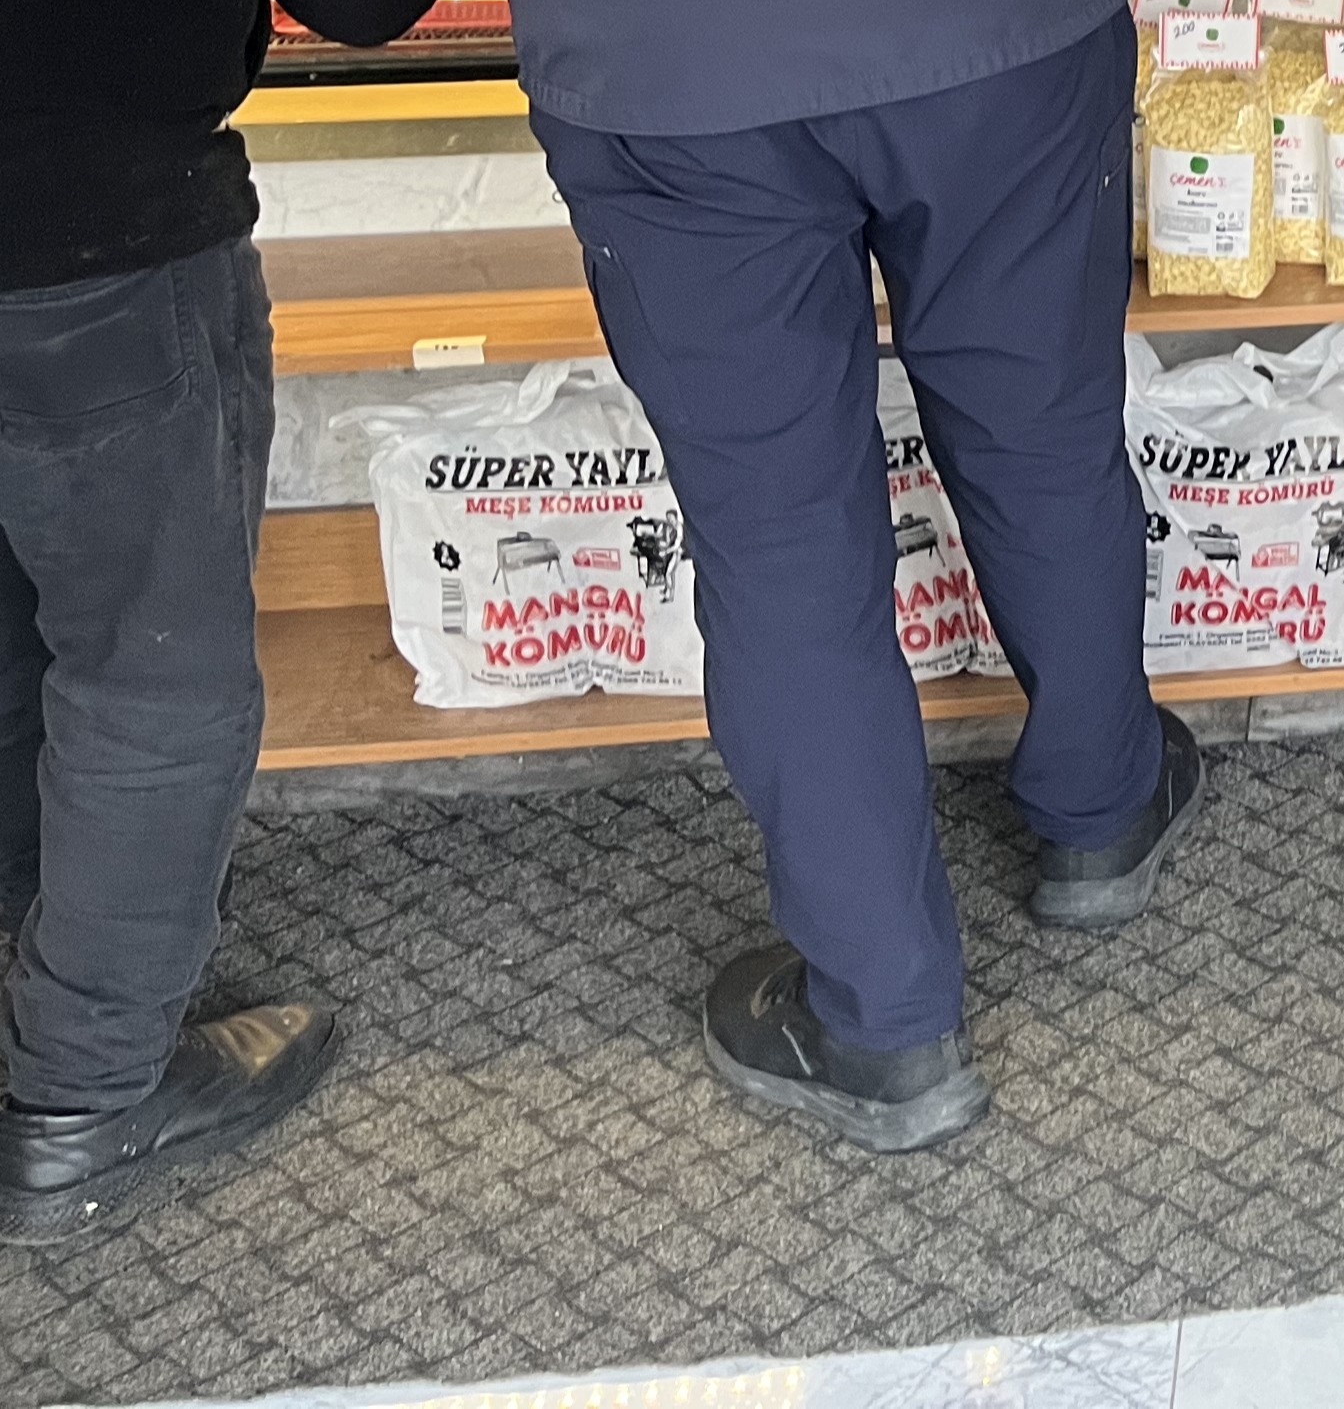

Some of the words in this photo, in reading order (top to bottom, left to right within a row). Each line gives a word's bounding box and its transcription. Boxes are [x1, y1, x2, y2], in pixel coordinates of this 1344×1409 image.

[1173, 20, 1196, 40] 200
[425, 446, 556, 489] SÜPER
[465, 495, 531, 520] MEŞE
[539, 490, 644, 515] KÖMÜRÜ
[1168, 483, 1229, 507] MEŞE
[1237, 477, 1335, 506] KÖMÜRÜ
[482, 584, 646, 632] MANGAL
[1176, 565, 1327, 612] MAGAL
[482, 613, 647, 668] KÖMÜRÜ
[1171, 591, 1327, 645] KÖMRÜ
